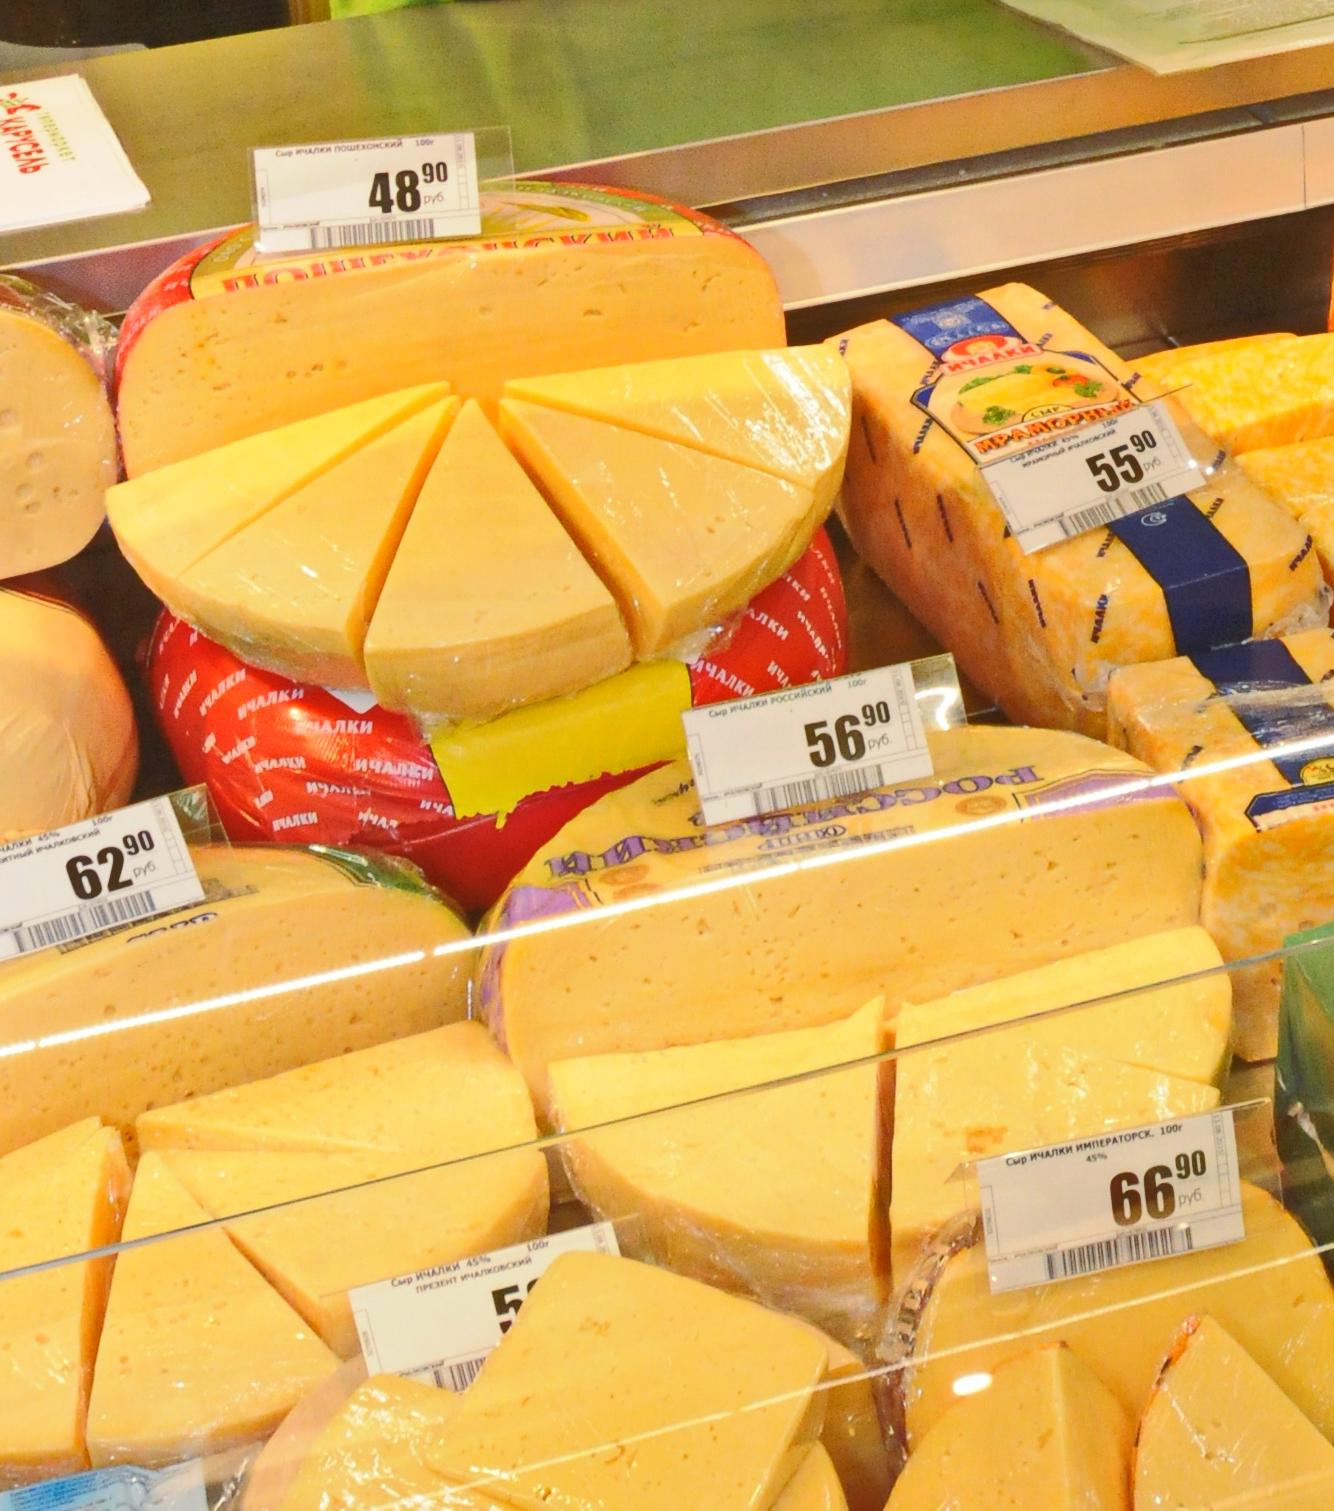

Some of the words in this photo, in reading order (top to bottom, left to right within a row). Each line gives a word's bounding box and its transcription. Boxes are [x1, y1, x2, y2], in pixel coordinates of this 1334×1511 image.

[335, 139, 403, 153] ПОШЕХОНСКИЙ
[368, 170, 421, 214] 48
[422, 161, 448, 184] 90
[947, 345, 1036, 373] ИЧАЛКИ
[1085, 444, 1144, 493] 55
[1130, 430, 1157, 453] 90
[200, 668, 246, 717] ИЧАЛКИ
[237, 688, 305, 720] ИЧАЛКИ
[708, 706, 728, 718] Сыр
[730, 698, 768, 713] ИЧАЛКИ
[770, 681, 832, 704] РОССИЙСКИЙ
[804, 714, 866, 768] 56
[861, 701, 891, 727] 90
[354, 758, 435, 782] ИЧАЛКИ
[38, 831, 61, 843] 45%
[65, 846, 134, 900] 62
[122, 830, 155, 856] 90
[1005, 1155, 1028, 1168] Сыр
[1030, 1145, 1073, 1161] ИЧАЛКИ
[1076, 1130, 1155, 1153] ИМПЕРАТОРСК.
[1160, 1124, 1183, 1136] 100г
[1085, 1152, 1107, 1163] 45%
[1110, 1164, 1175, 1226] 66
[1175, 1150, 1206, 1180] 90
[391, 1275, 413, 1288] Сыр
[415, 1262, 461, 1282] ИЧАЛКИ
[466, 1254, 491, 1268] 45%
[526, 1241, 549, 1253] 100г
[416, 1276, 458, 1294] ПРЕЗЕНТ
[460, 1255, 533, 1282] ИЧАЛКОВСКИЙ
[491, 1278, 539, 1334] 5
